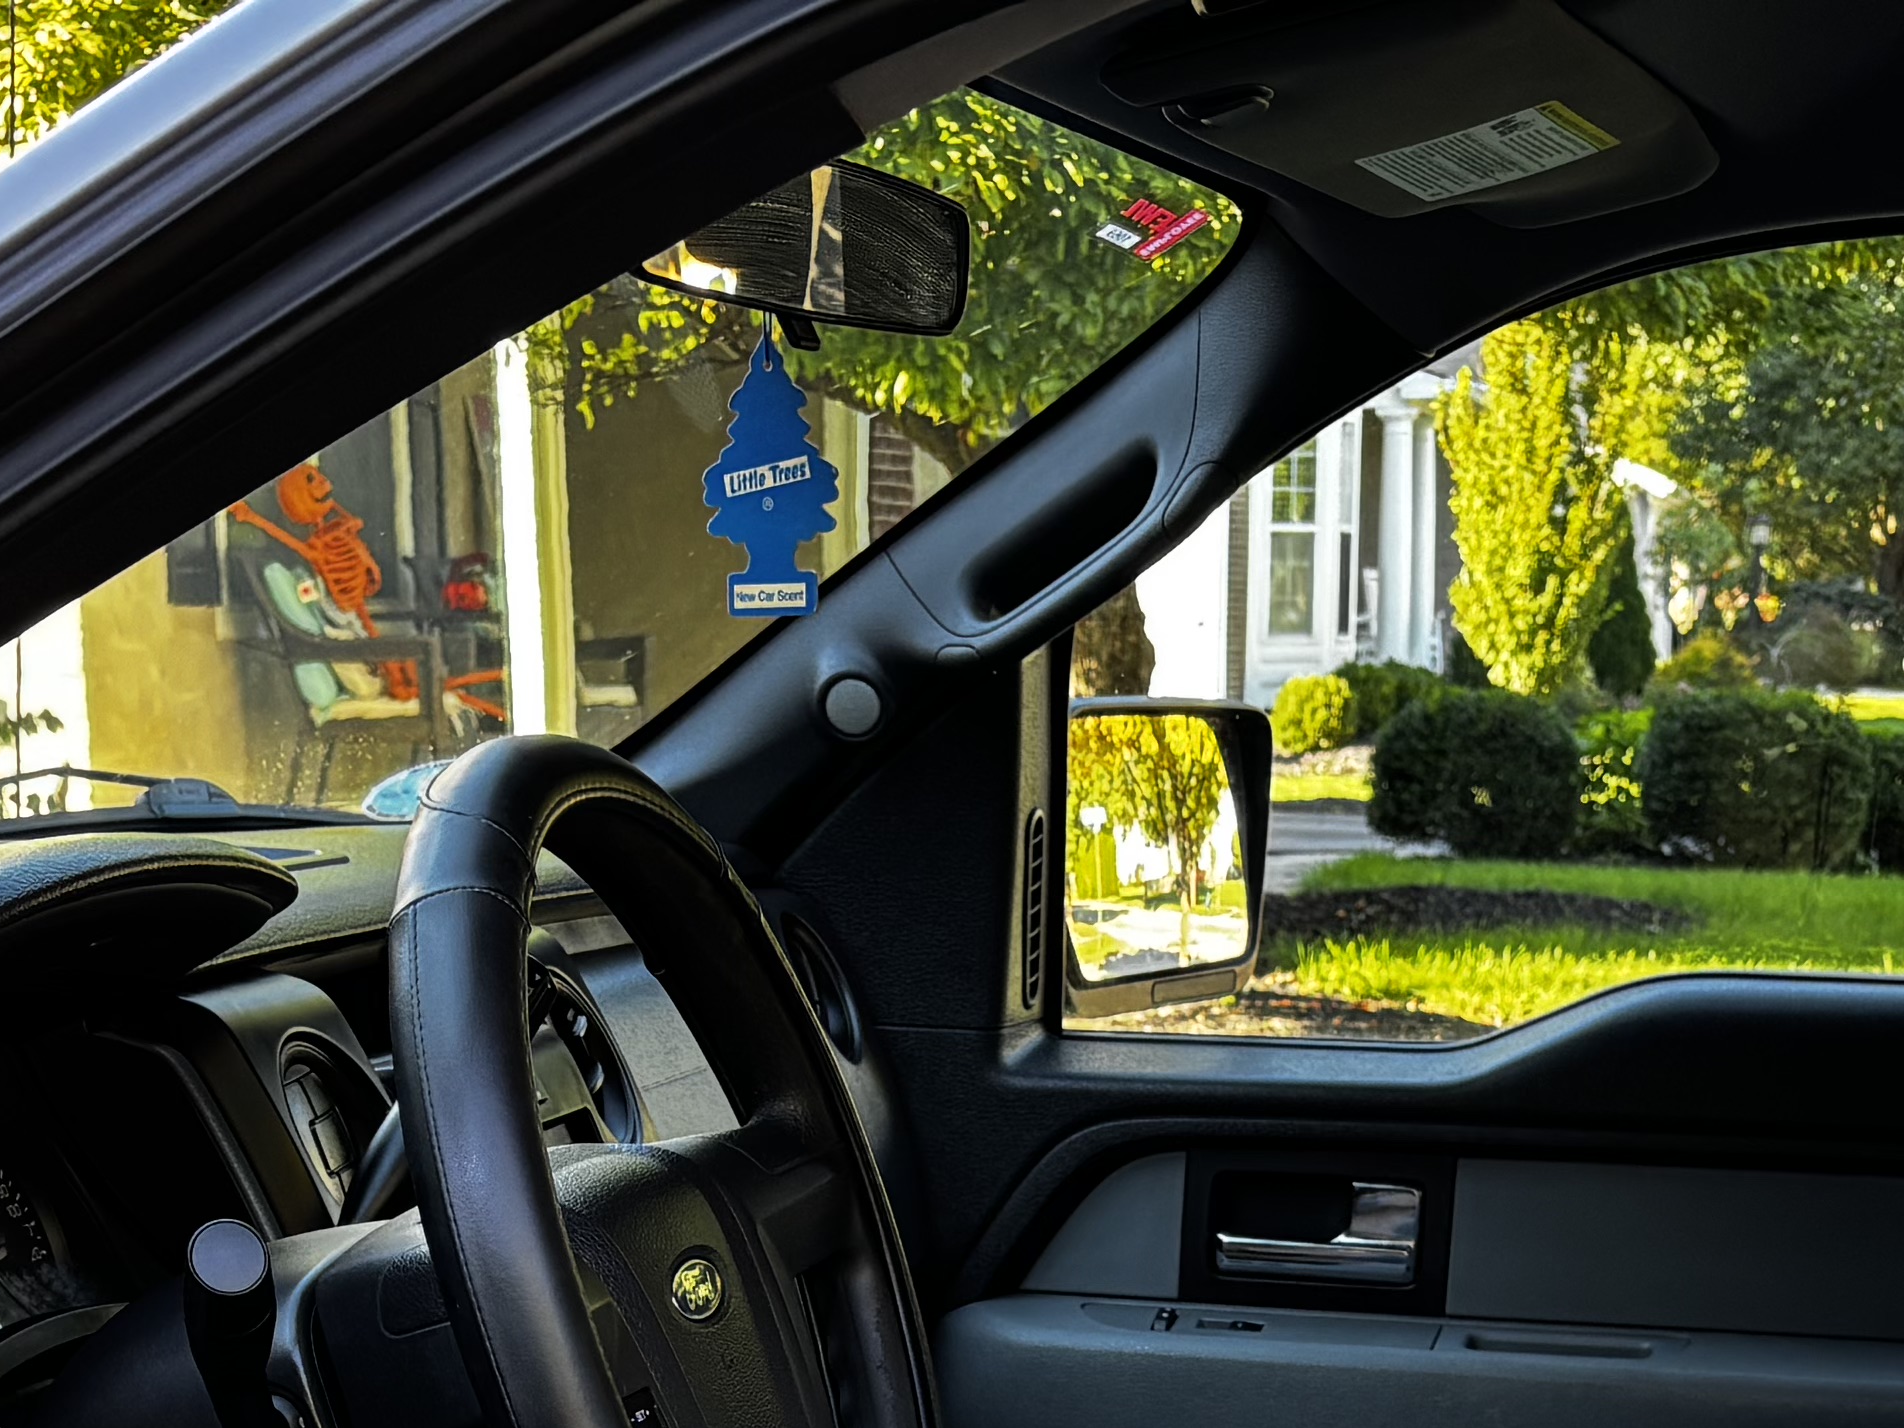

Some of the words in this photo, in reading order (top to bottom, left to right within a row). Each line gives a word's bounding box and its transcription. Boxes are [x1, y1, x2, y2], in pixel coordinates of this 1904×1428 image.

[728, 470, 767, 494] Little
[769, 461, 808, 484] Trees
[758, 589, 776, 602] Car
[777, 588, 804, 602] Scent
